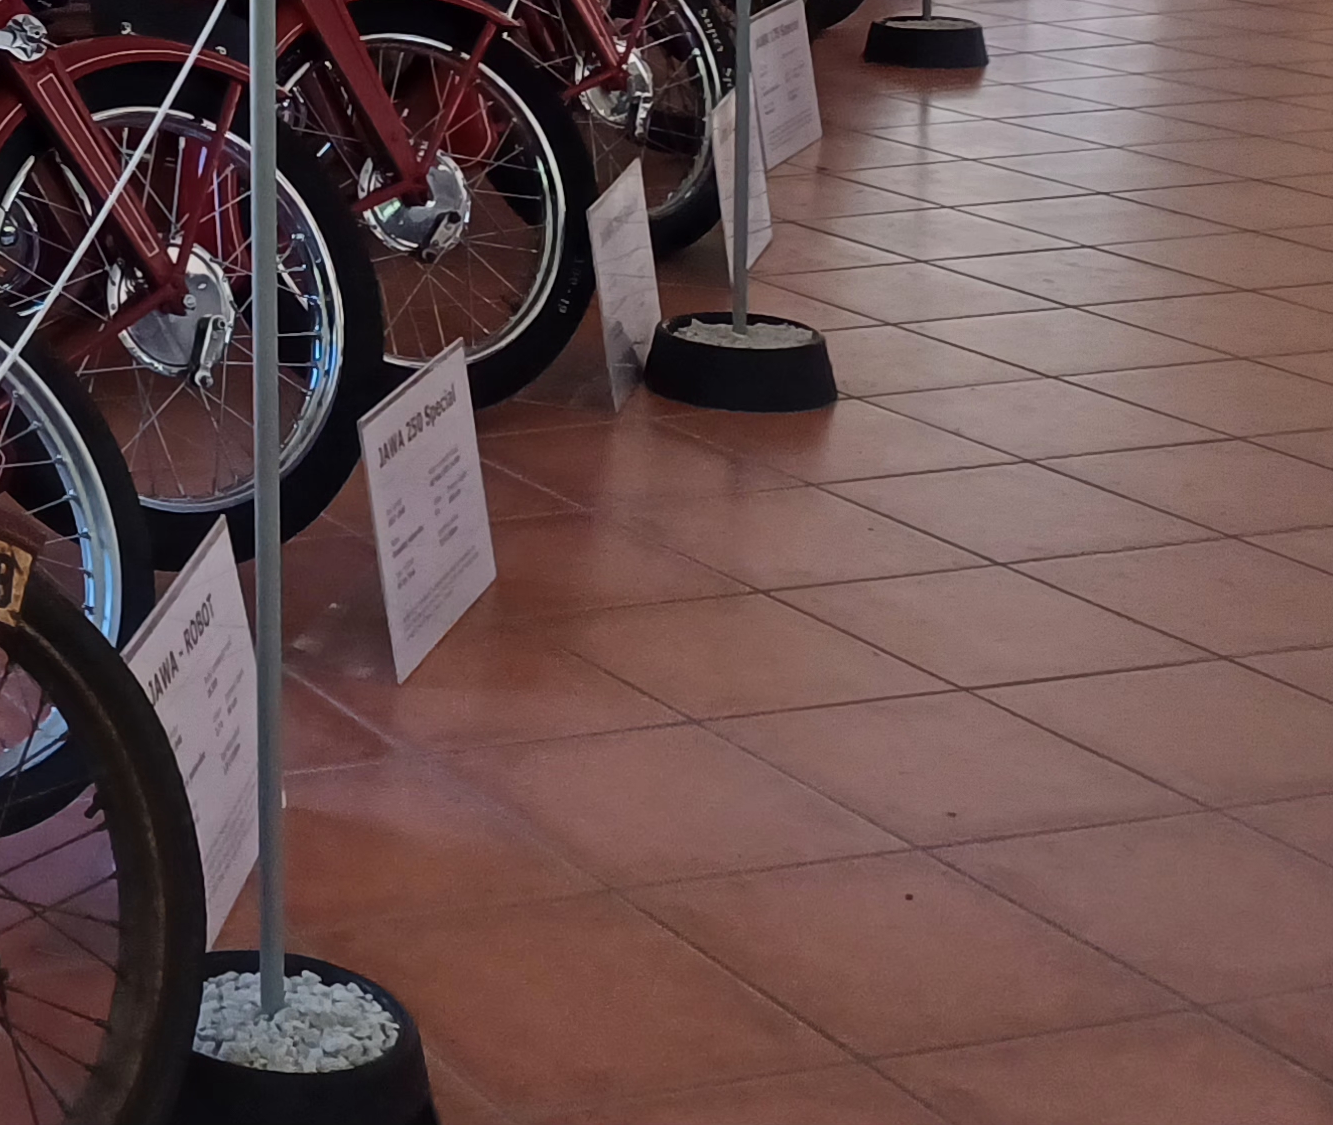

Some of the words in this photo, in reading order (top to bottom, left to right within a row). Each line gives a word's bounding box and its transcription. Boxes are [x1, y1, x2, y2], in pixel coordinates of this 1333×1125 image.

[378, 430, 406, 469] JAWA
[405, 412, 424, 443] 250
[423, 382, 457, 427] Special
[148, 651, 180, 707] JAWA
[182, 592, 215, 655] ROBOT
